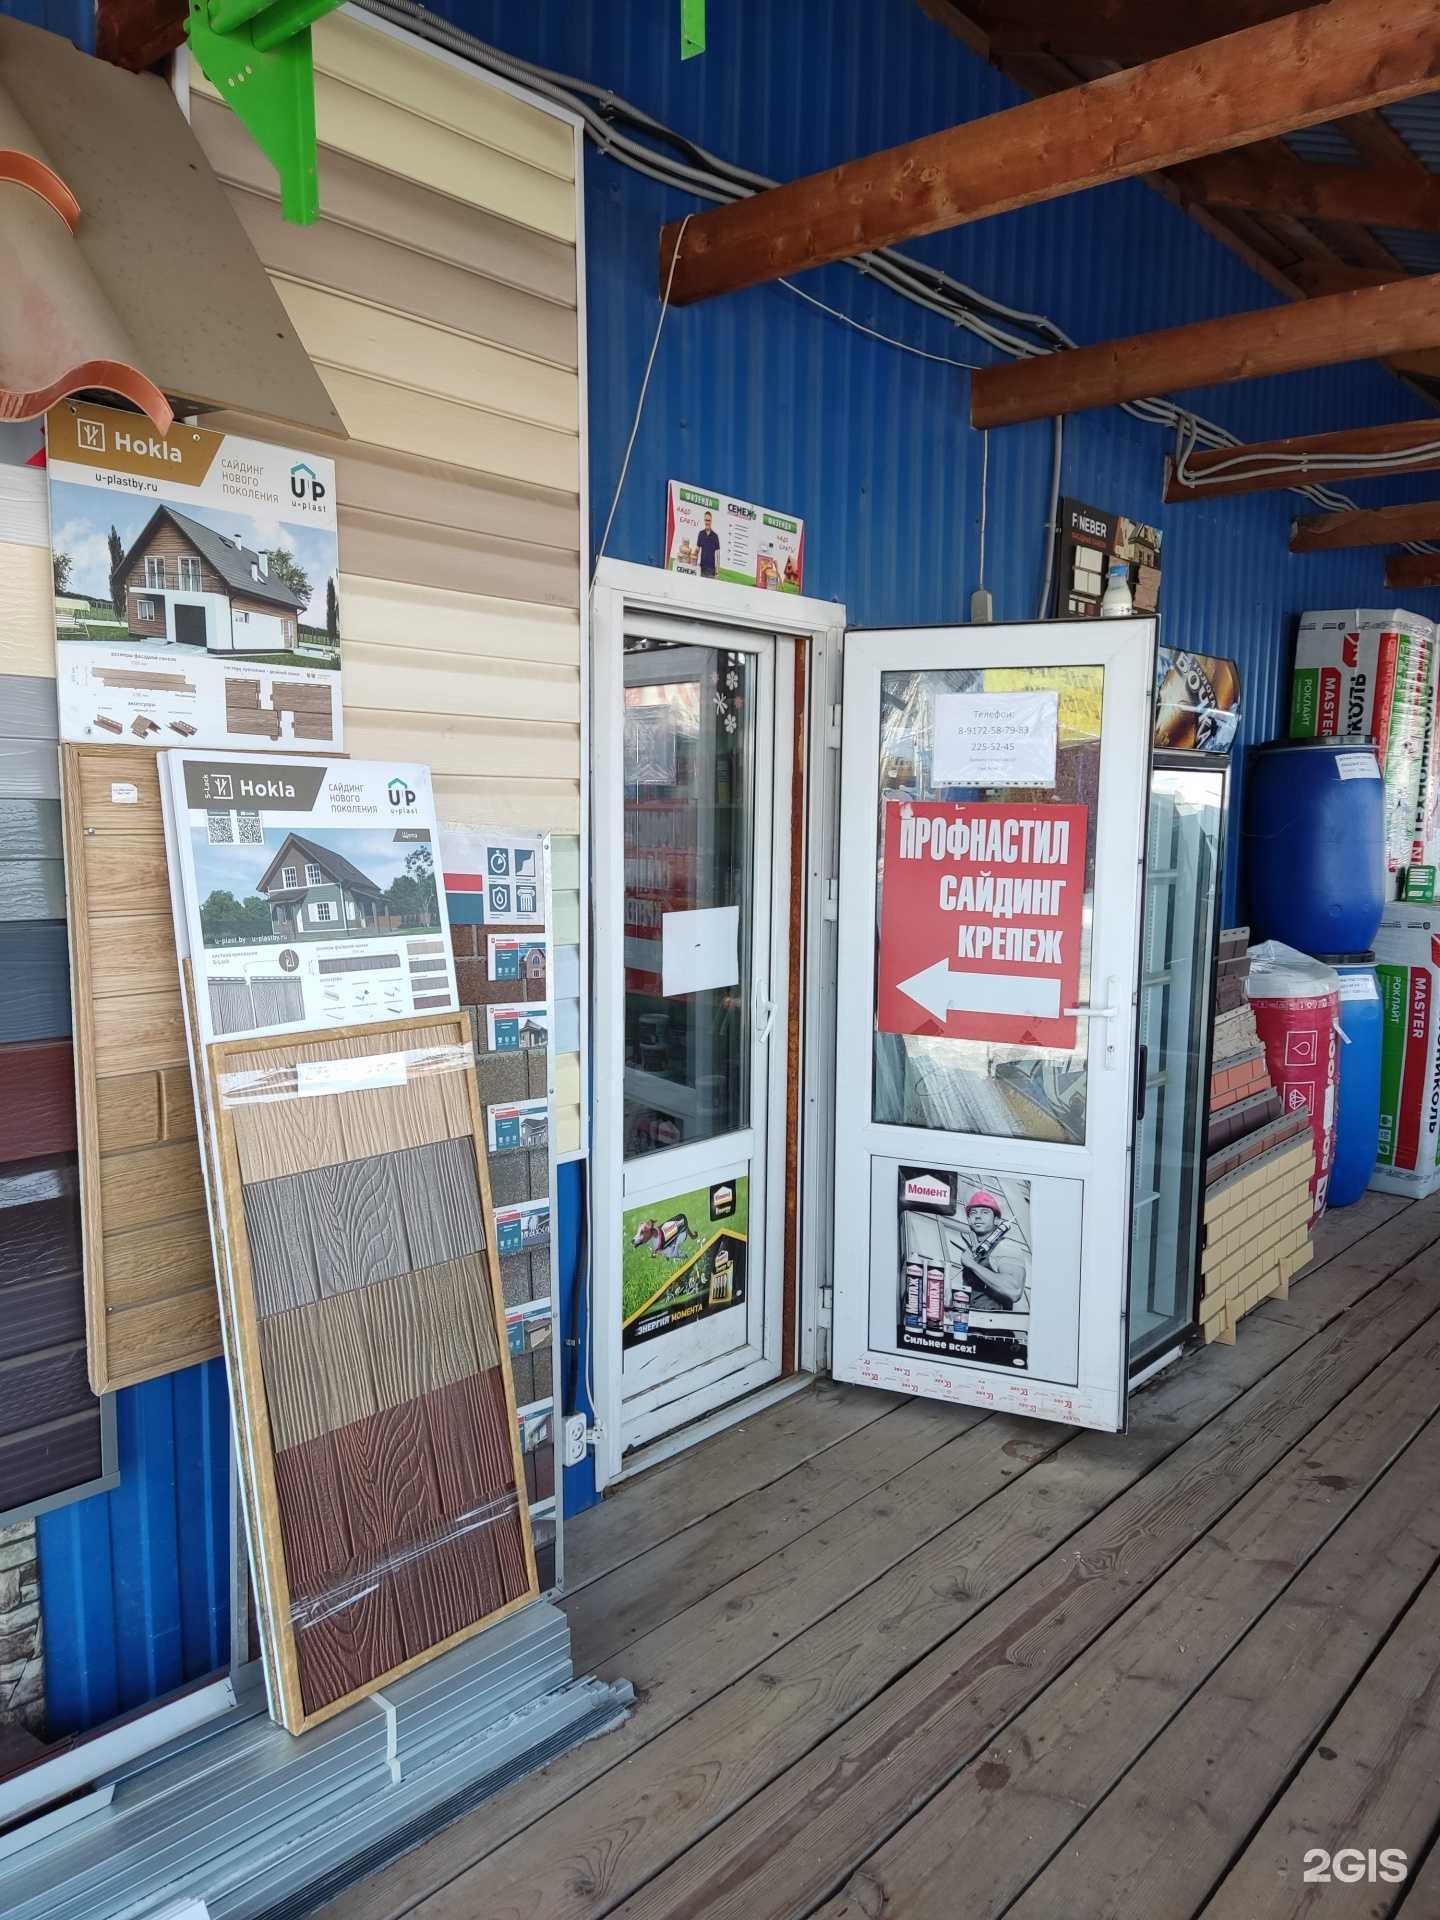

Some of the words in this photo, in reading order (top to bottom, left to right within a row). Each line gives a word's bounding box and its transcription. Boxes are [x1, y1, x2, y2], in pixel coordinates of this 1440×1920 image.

[115, 431, 183, 463] Hokla
[221, 458, 265, 475] САЙДИНГ
[95, 473, 159, 493] u-plastby.ru
[222, 472, 259, 487] НОВОГО
[222, 485, 280, 504] ПОКОЛЕНИЯ
[1302, 678, 1313, 726] РОКЛАЙТ
[239, 779, 296, 799] Hokla
[328, 783, 365, 793] САЙДИНГ
[329, 793, 361, 803] НОВОГО
[331, 803, 378, 814] ПОКОЛЕНИЯ
[899, 816, 1070, 865] ПРОФНАСТИЛ
[939, 870, 1067, 919] САЙДИНГ
[958, 924, 1064, 965] КРЕПЕЖ
[1390, 976, 1401, 1024] РОКЛАЙТ
[1412, 976, 1427, 1040] MASTER
[908, 1183, 948, 1199] Момент
[671, 1303, 703, 1323] МОМЕНТА
[903, 1334, 947, 1350] Сильнее
[949, 1341, 977, 1355] всех!
